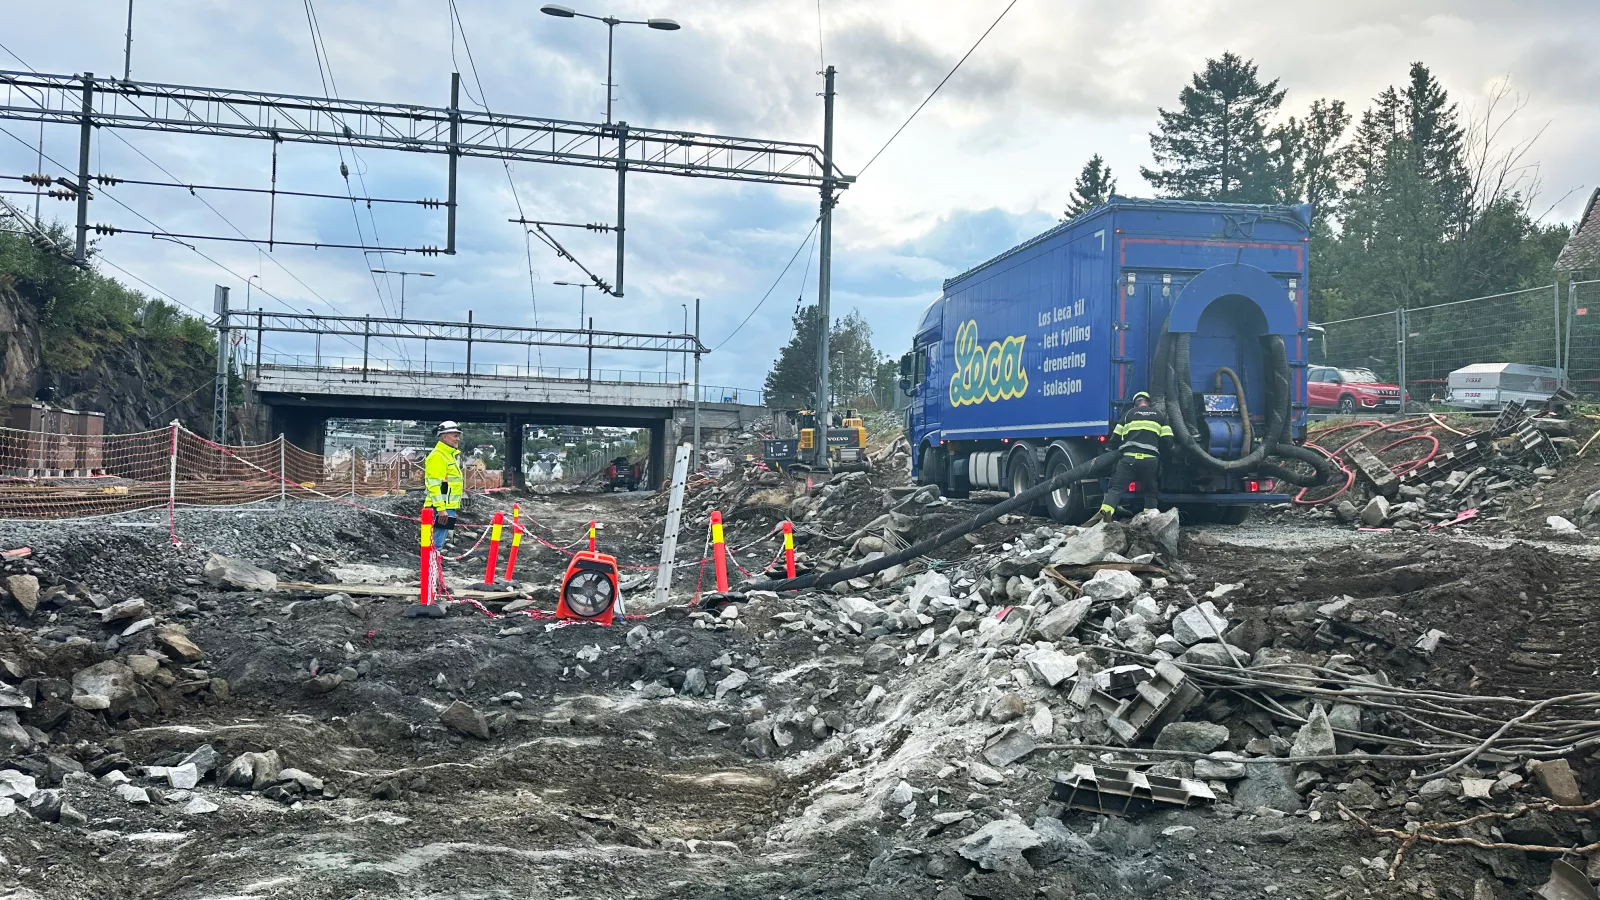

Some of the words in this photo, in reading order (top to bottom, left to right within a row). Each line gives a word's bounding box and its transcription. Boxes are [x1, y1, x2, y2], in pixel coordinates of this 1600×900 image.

[1038, 311, 1051, 327] Løs
[1053, 305, 1072, 323] Leca
[1074, 298, 1085, 317] til
[1043, 331, 1059, 349] lett
[1061, 325, 1091, 346] fylling
[949, 319, 1029, 408] Leca
[1043, 351, 1086, 373] drenering
[1043, 377, 1082, 396] isolasjon
